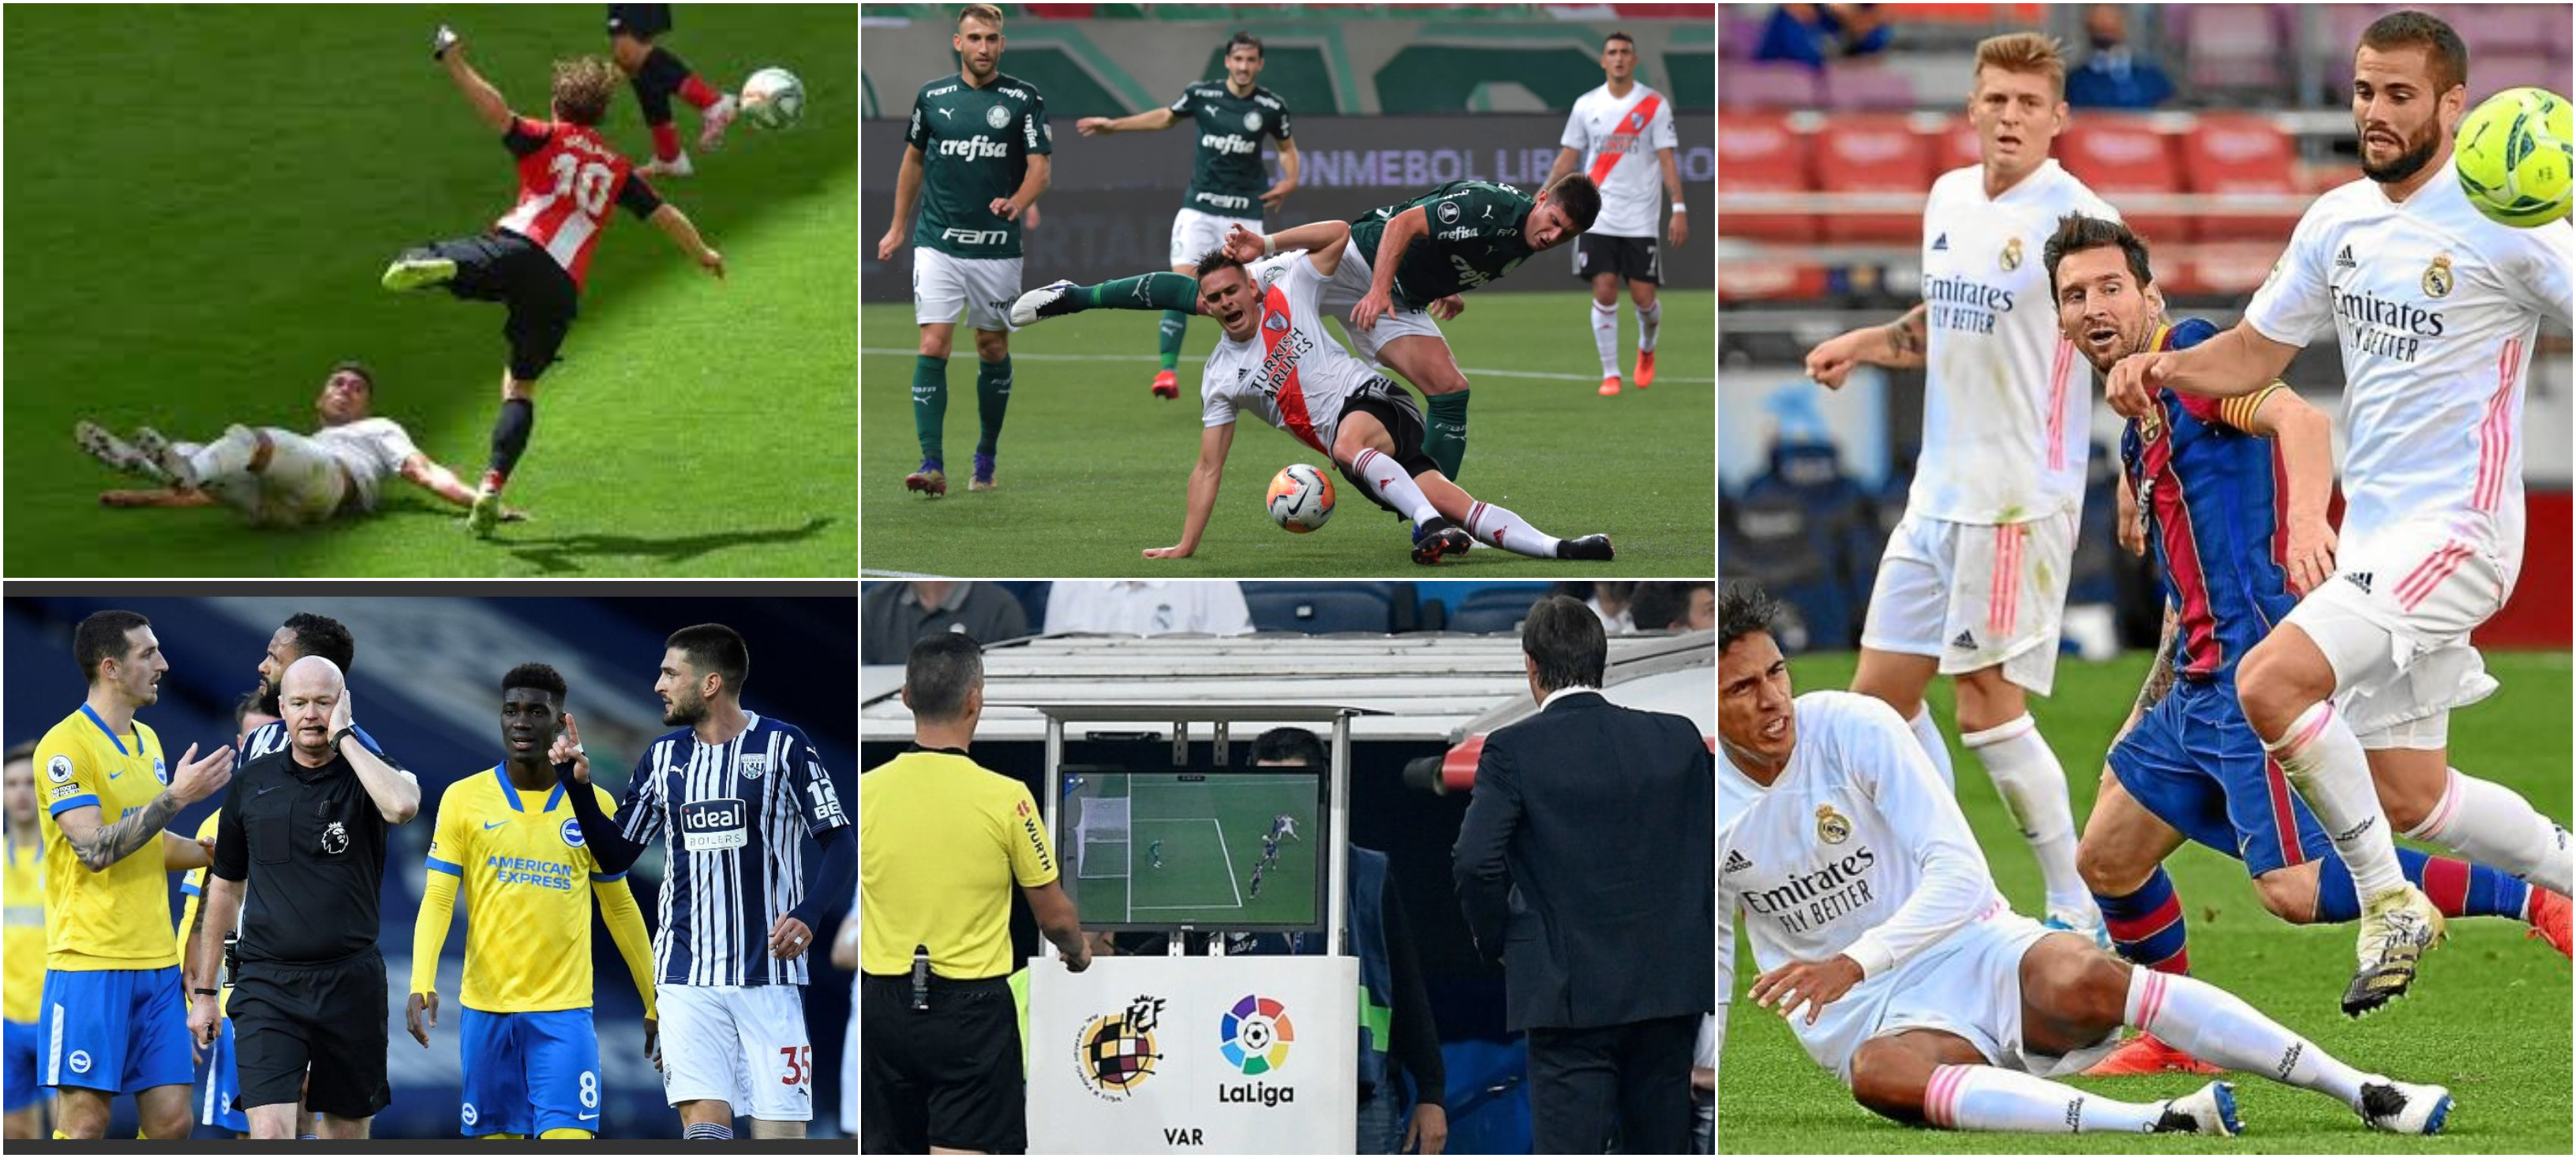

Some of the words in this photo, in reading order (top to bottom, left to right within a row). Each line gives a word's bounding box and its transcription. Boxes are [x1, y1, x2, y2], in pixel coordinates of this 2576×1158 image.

[1024, 114, 1038, 148] crefisa
[1202, 133, 1256, 156] crefisa
[940, 135, 1009, 162] crefisa
[1437, 226, 1478, 241] crefisa
[1925, 274, 2014, 313] Emirates
[2330, 285, 2443, 336] Emirates
[1250, 327, 1304, 391] TURKISH
[2363, 328, 2419, 362] BETTER
[1264, 338, 1313, 401] AIRLINES
[806, 778, 837, 806] 12
[685, 804, 740, 829] ideal
[690, 834, 742, 846] BOILERS
[487, 856, 572, 876] AMERICAN
[497, 870, 571, 890] EXPRESS
[1741, 845, 1874, 913] Emirates
[1779, 908, 1809, 934] FLY
[1810, 879, 1874, 925] BETTER
[780, 1045, 811, 1085] 35
[578, 1070, 598, 1107] 8
[1219, 1081, 1294, 1107] LaLiga
[1163, 1128, 1204, 1145] VAR
